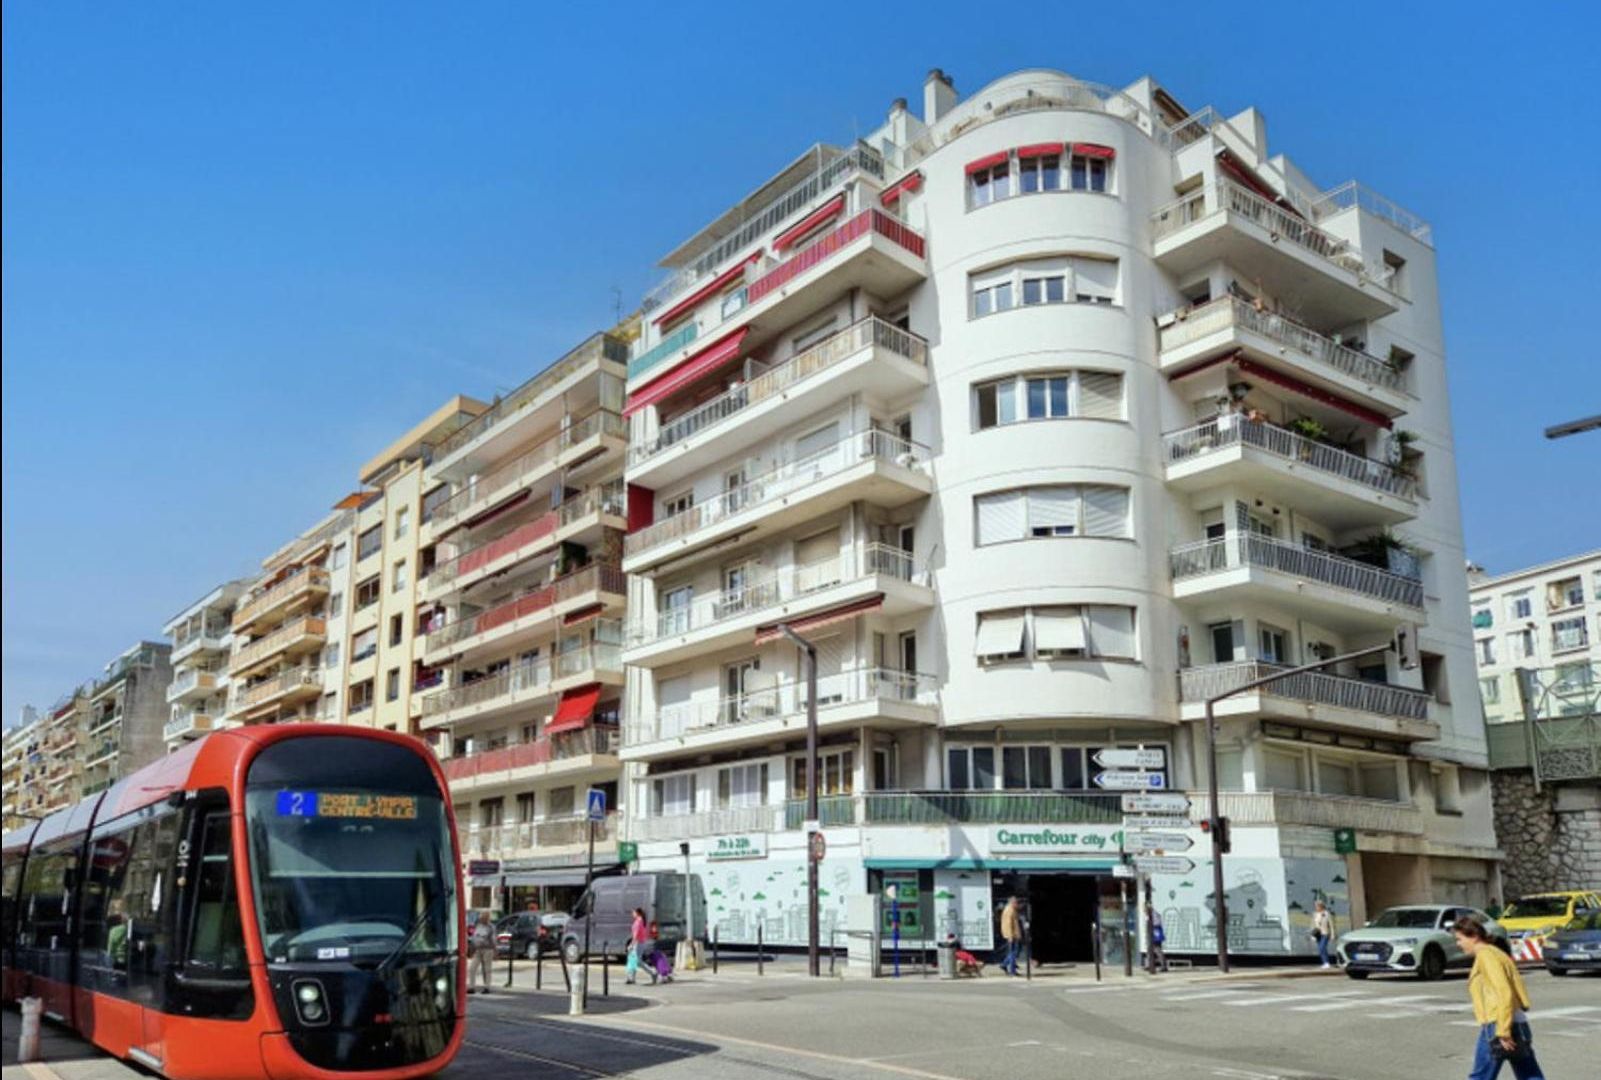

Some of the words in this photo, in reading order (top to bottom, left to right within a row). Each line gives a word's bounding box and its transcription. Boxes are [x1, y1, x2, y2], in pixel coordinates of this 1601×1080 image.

[291, 792, 304, 815] 2
[997, 828, 1078, 845] Carrefour
[1081, 833, 1106, 848] city
